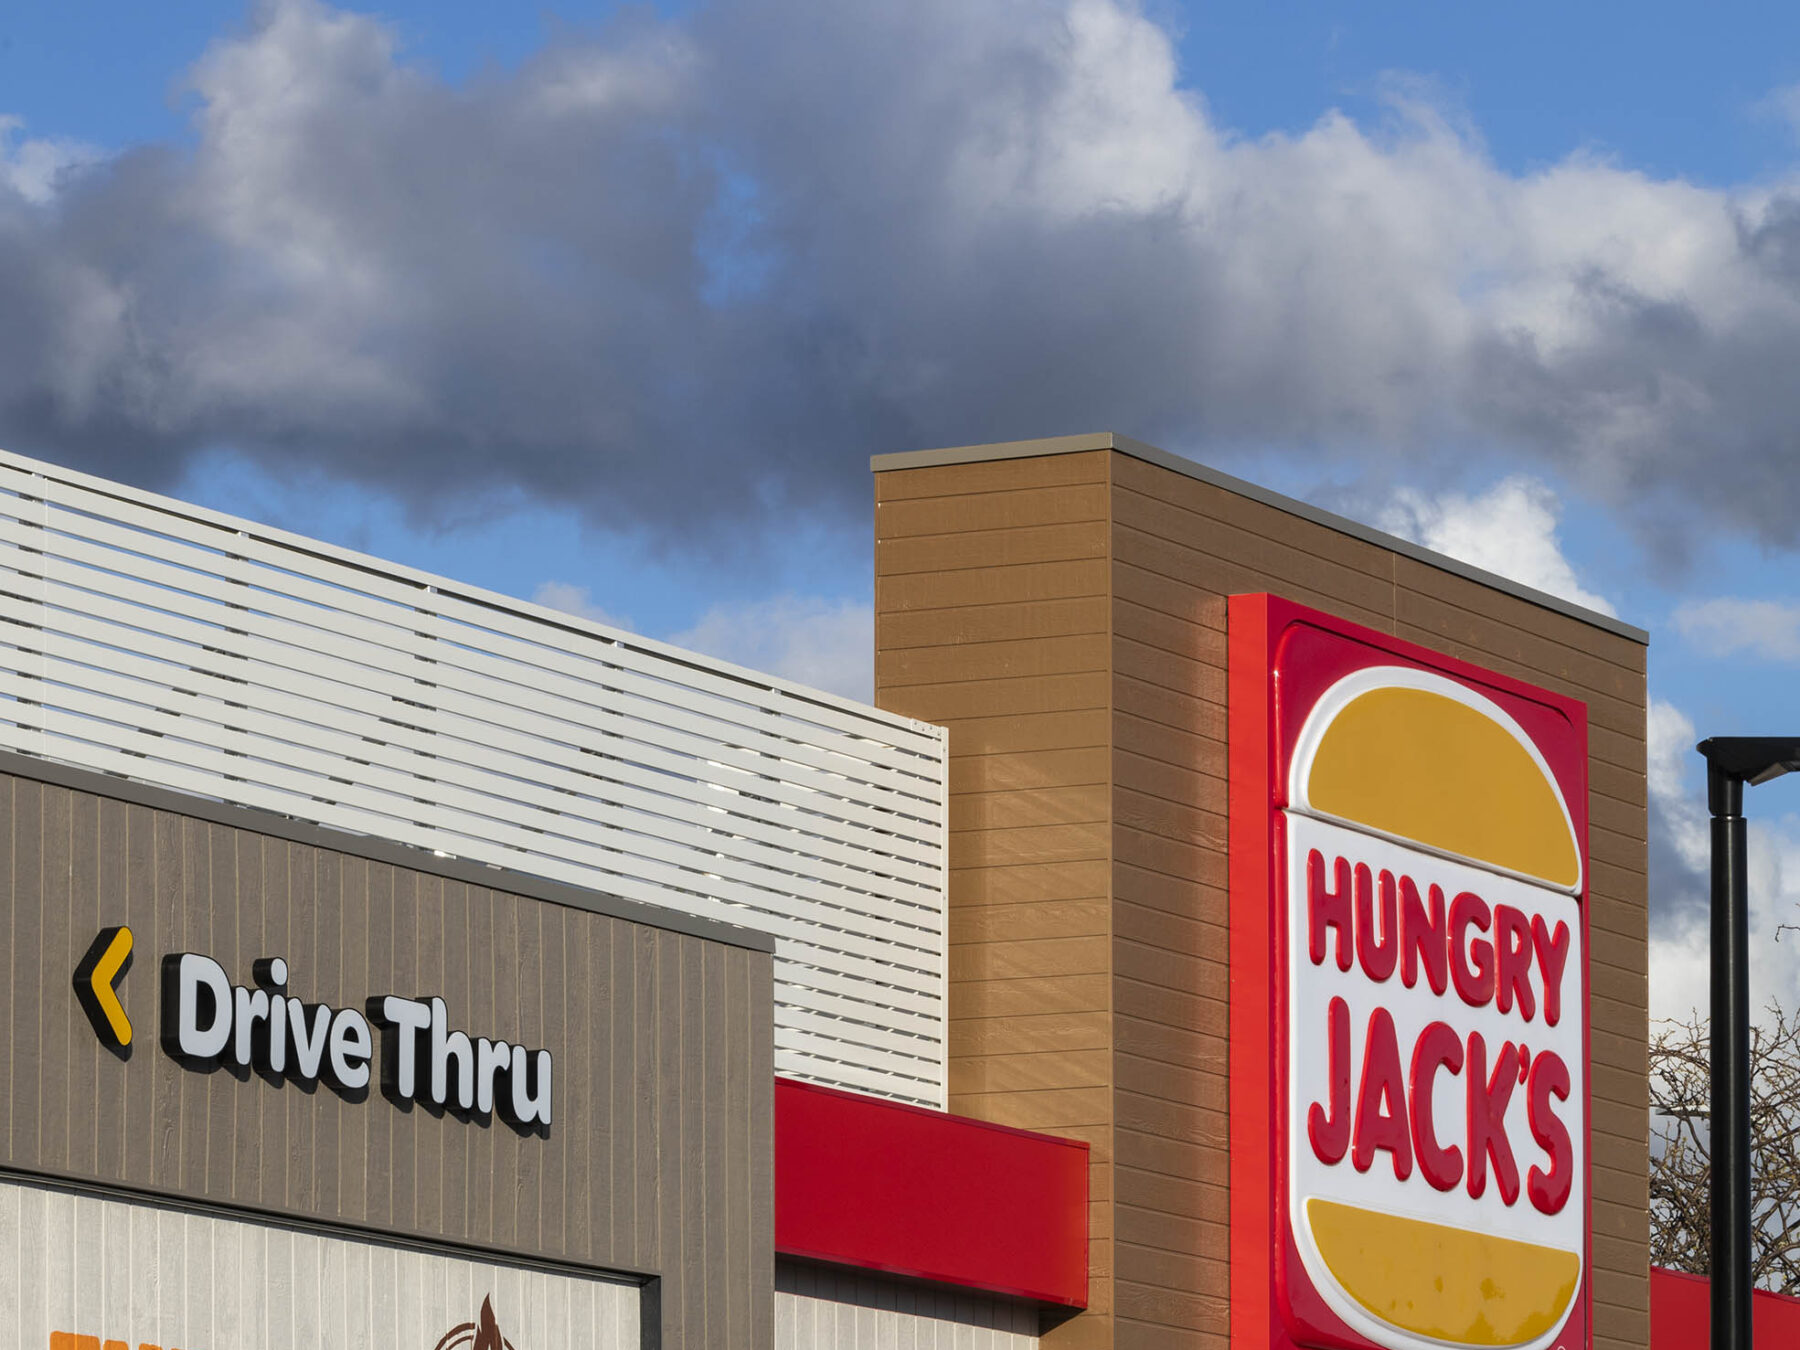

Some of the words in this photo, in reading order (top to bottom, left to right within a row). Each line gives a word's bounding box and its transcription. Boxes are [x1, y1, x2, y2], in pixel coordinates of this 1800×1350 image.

[1306, 846, 1571, 1028] HUNGRY
[163, 952, 373, 1090] Drive
[369, 994, 553, 1125] Thru
[1306, 995, 1574, 1217] JACK'S
